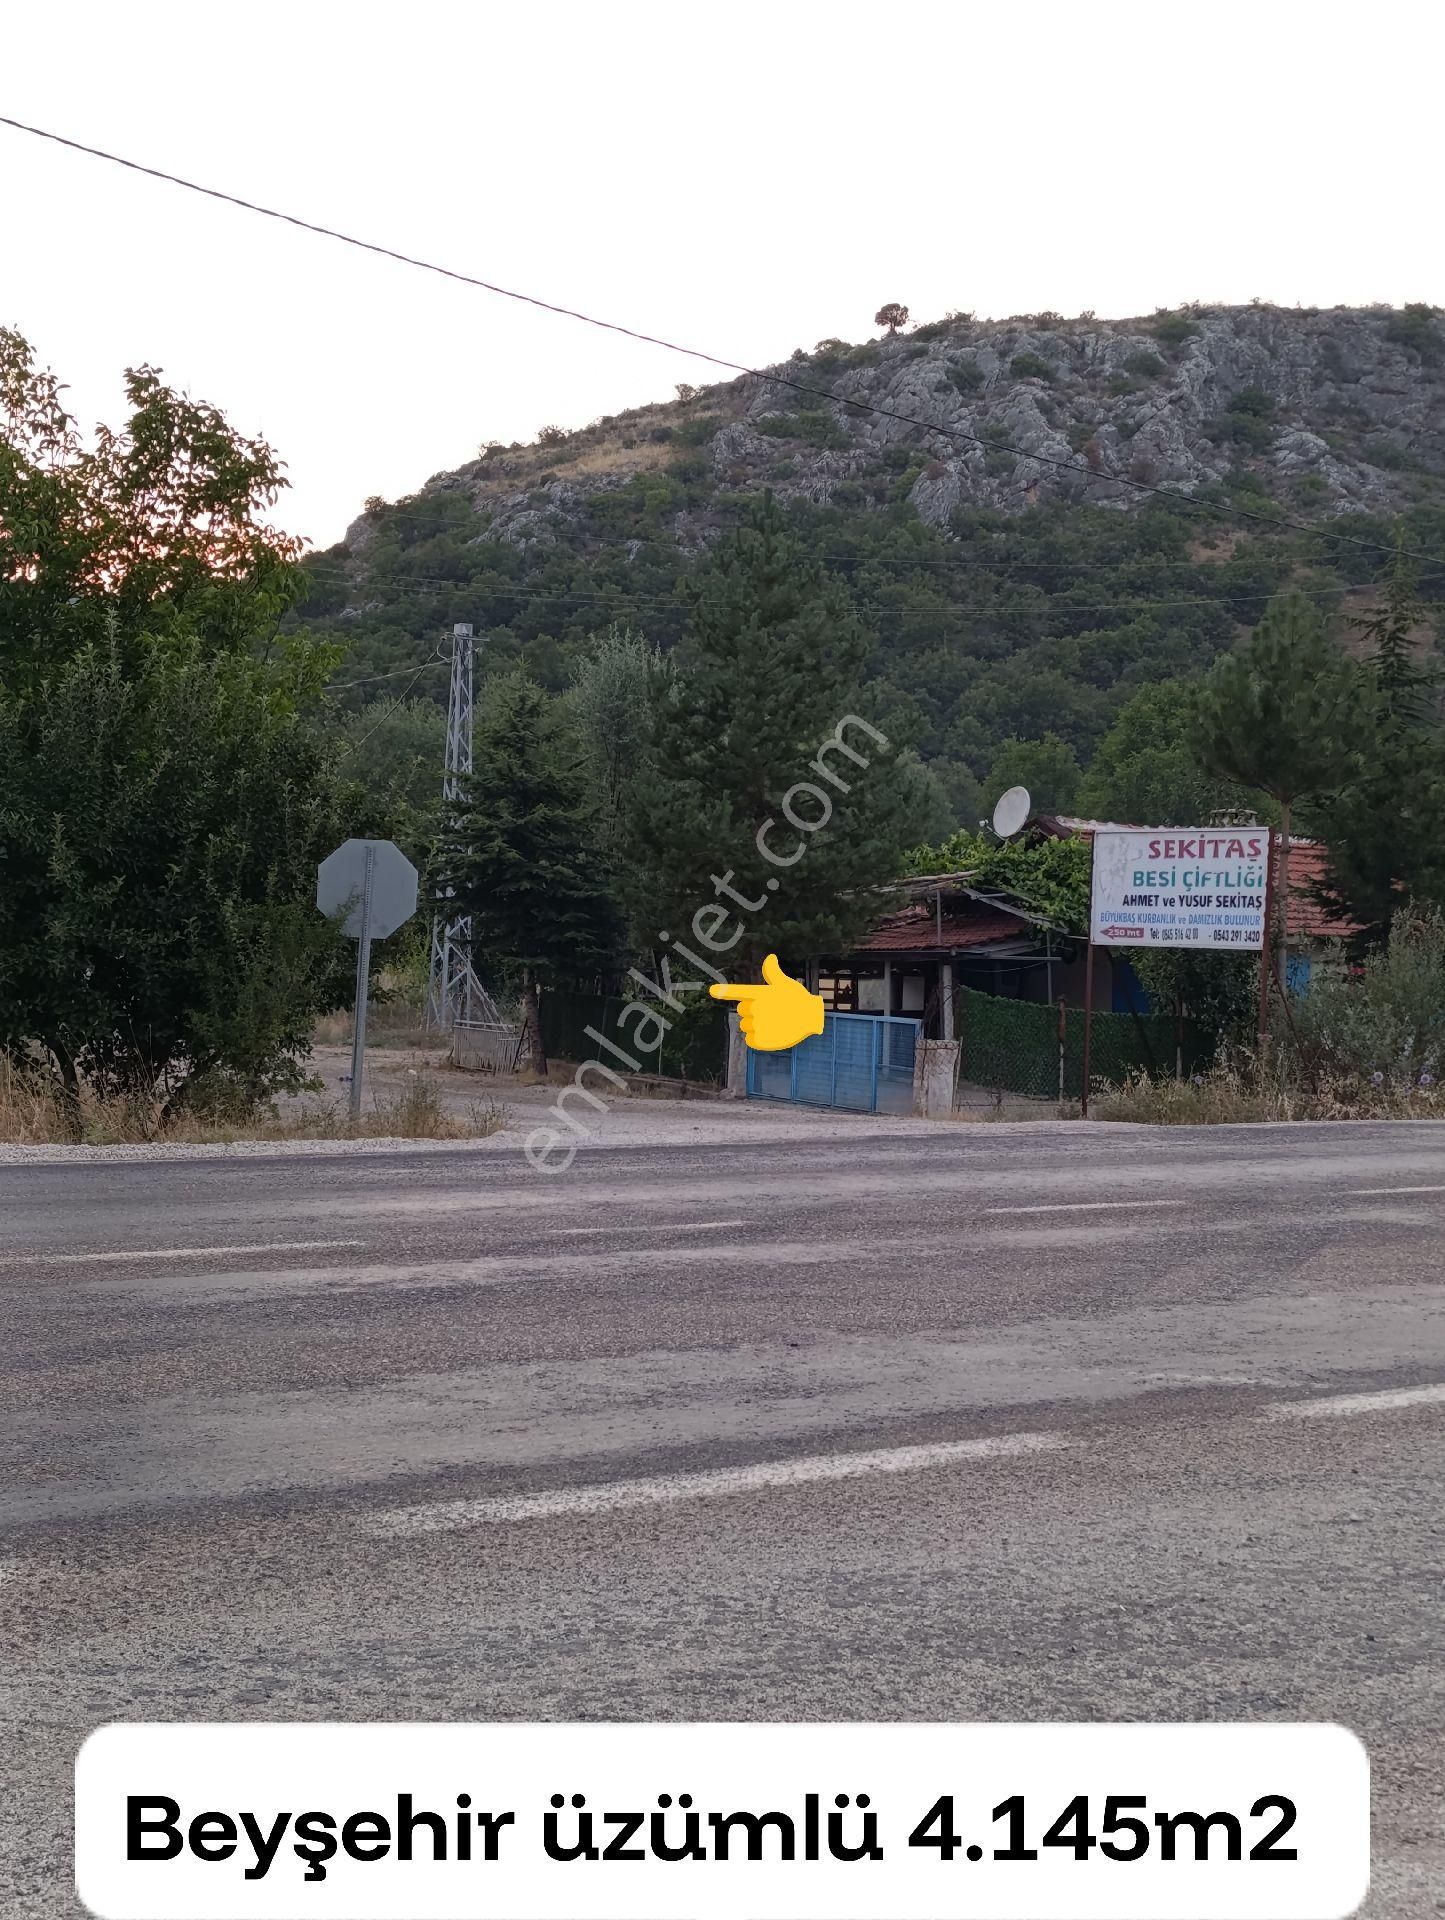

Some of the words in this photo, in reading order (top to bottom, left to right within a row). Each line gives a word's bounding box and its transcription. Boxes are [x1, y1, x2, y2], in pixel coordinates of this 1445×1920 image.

[1148, 834, 1261, 862] SEKİTAŞ
[1133, 866, 1176, 887] BESİ
[1183, 865, 1263, 891] ÇİFTLİĞİ
[1123, 894, 1159, 907] AHMET
[1163, 898, 1175, 907] ve
[1179, 895, 1213, 908] YUSUF
[1216, 892, 1262, 910] SEKİTAŞ
[1101, 911, 1136, 926] BÜYÜKBAŞ
[1137, 912, 1176, 924] KURBANLIK
[1178, 917, 1186, 925] ve
[1189, 914, 1222, 925] DAMIZLIK
[1223, 915, 1260, 926] BULUNUR
[1107, 929, 1125, 937] 250
[1127, 928, 1140, 937] mt
[1150, 928, 1160, 940] Tel:
[1214, 930, 1229, 941] 0543
[1231, 931, 1242, 942] 291
[1244, 931, 1260, 942] 3420
